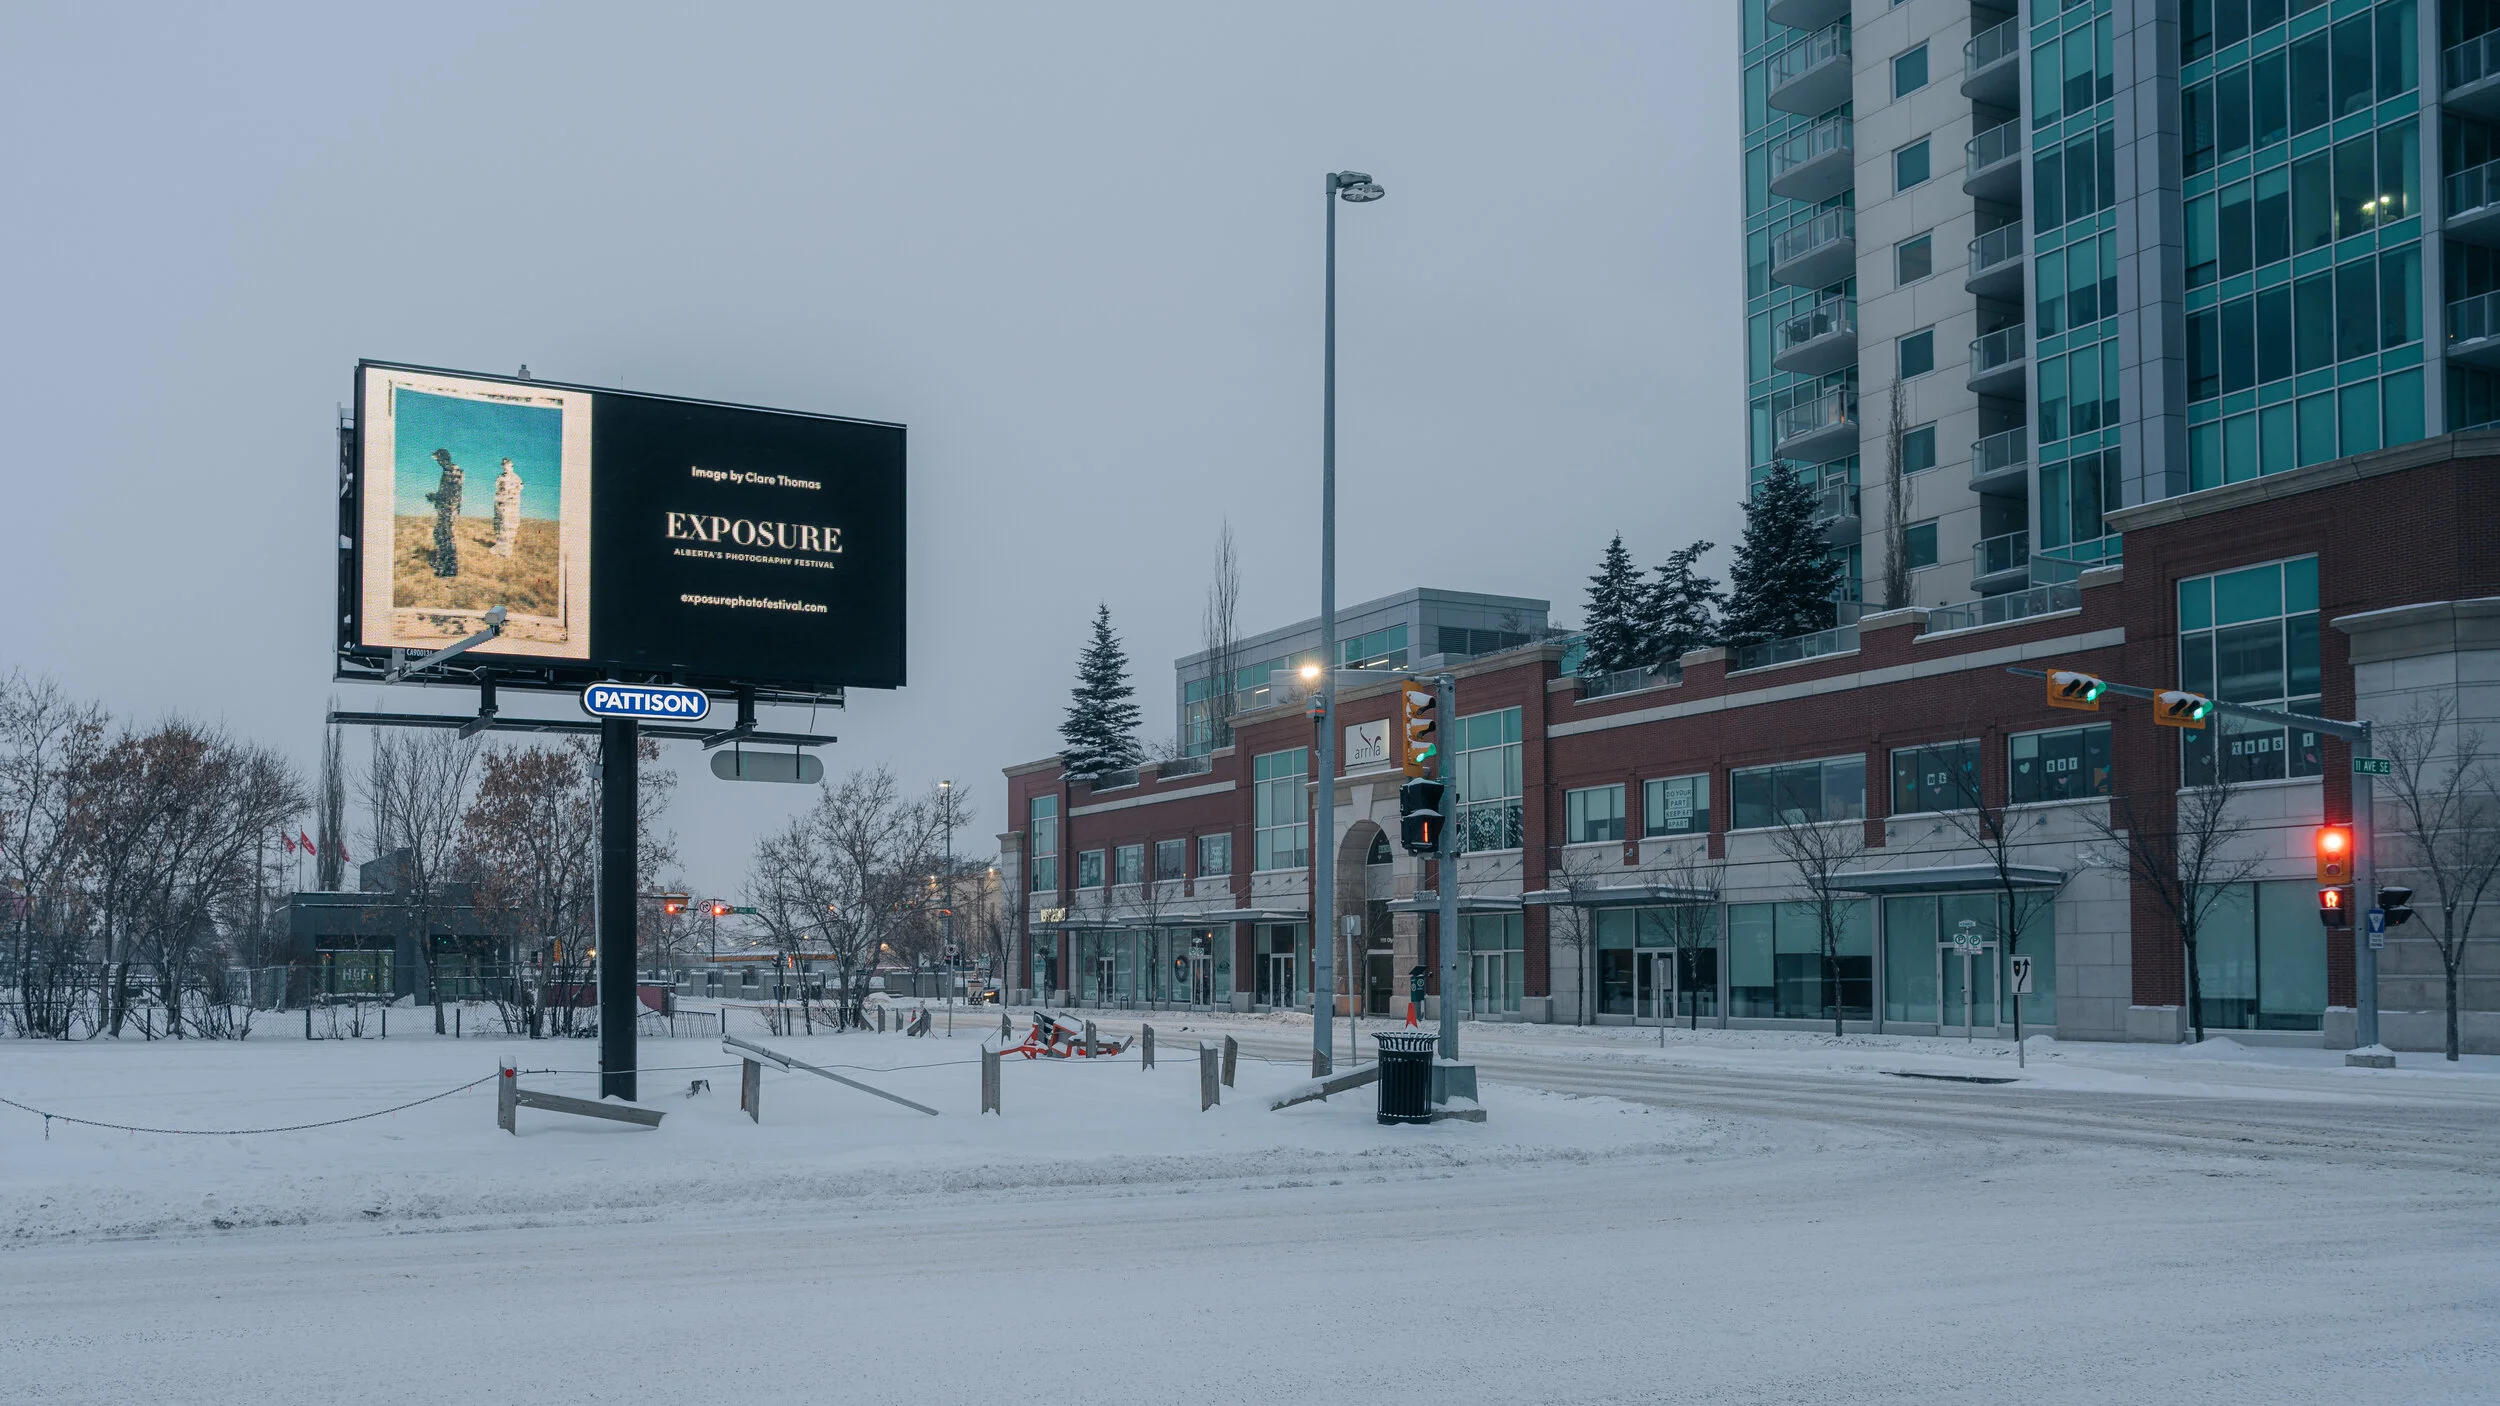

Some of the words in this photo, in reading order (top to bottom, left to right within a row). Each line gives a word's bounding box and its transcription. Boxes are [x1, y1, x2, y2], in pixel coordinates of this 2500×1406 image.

[692, 466, 728, 481] Image
[730, 470, 744, 484] by
[745, 471, 776, 485] Clare
[777, 475, 821, 490] Thomas
[665, 511, 843, 553] EXPOSURE
[673, 548, 723, 559] ALBERTA'S
[725, 552, 792, 566] PHOTOGRAPHY
[794, 558, 835, 569] FESTIVAL
[680, 593, 828, 613] exposurephotofestival.com
[595, 690, 699, 714] PATTISON
[2232, 737, 2284, 755] THIS
[2364, 760, 2377, 772] AVE
[2380, 761, 2389, 773] SE
[1670, 799, 1686, 807] PART
[1676, 789, 1692, 797] YOUR
